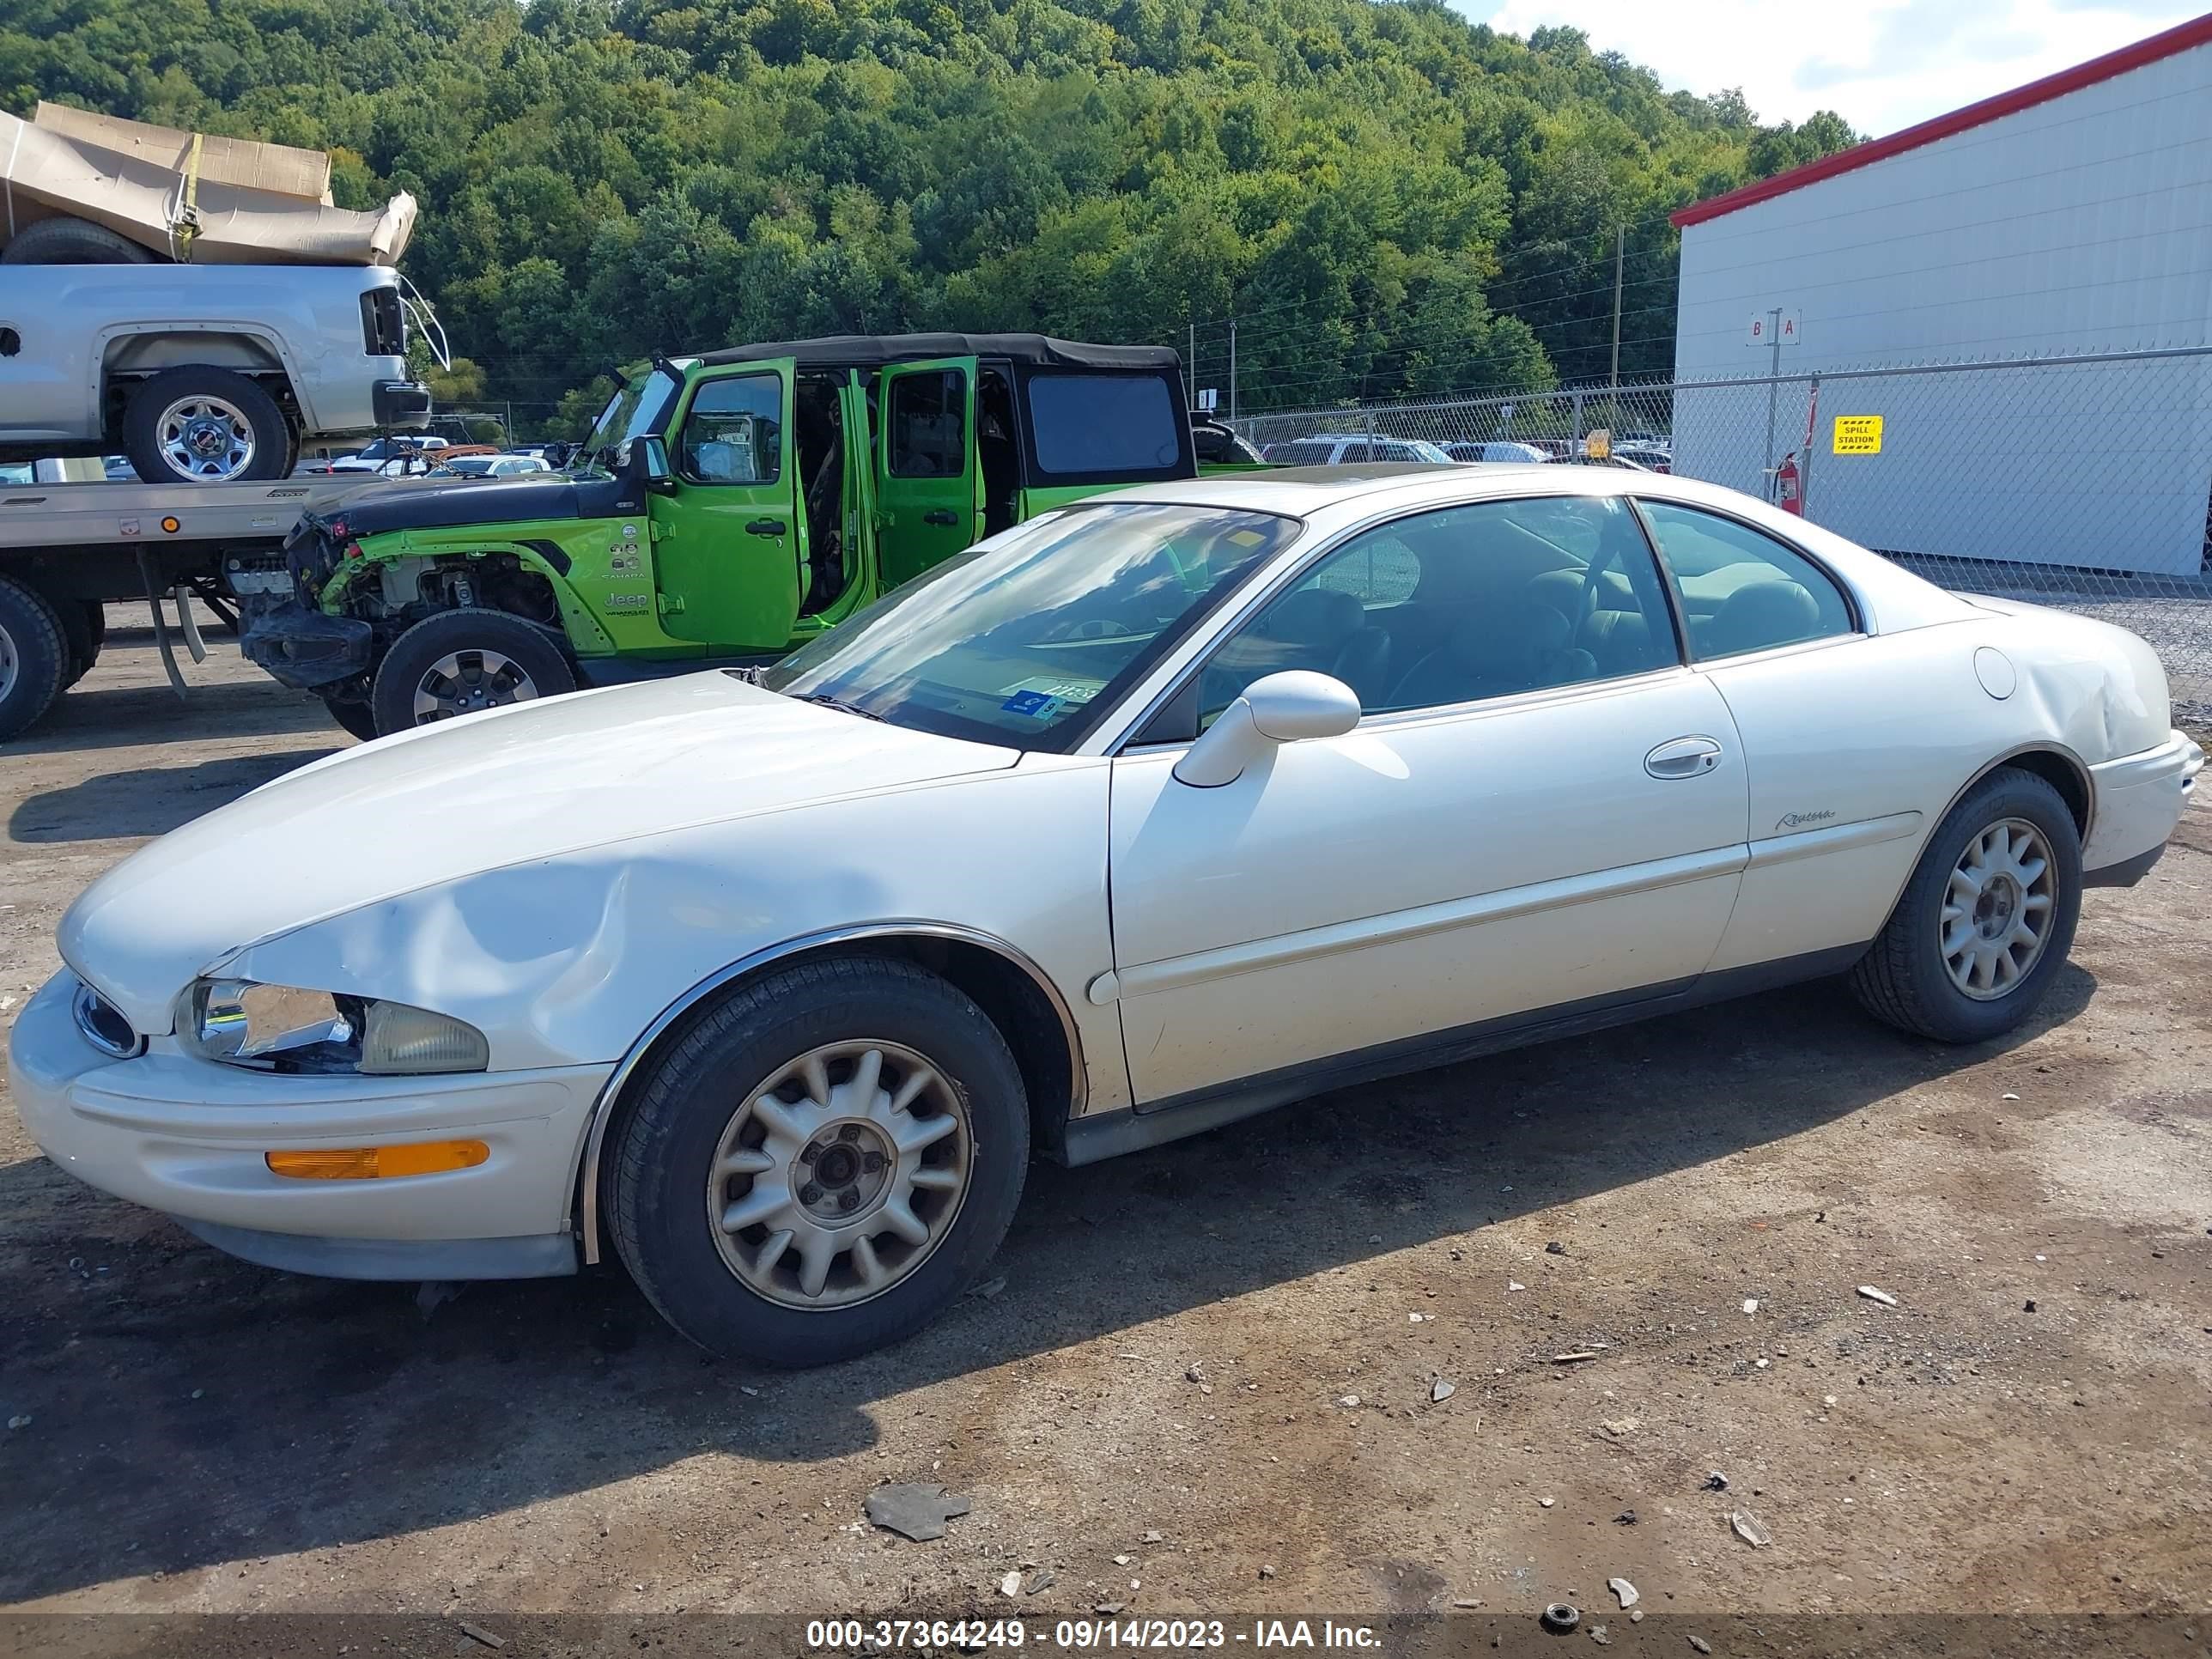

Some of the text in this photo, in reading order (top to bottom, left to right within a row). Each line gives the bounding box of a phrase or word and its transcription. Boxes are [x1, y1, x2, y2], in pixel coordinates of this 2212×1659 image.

[1753, 321, 1761, 336] B
[1784, 319, 1794, 334] A
[1838, 435, 1875, 444] STATION
[604, 592, 647, 608] Jeep
